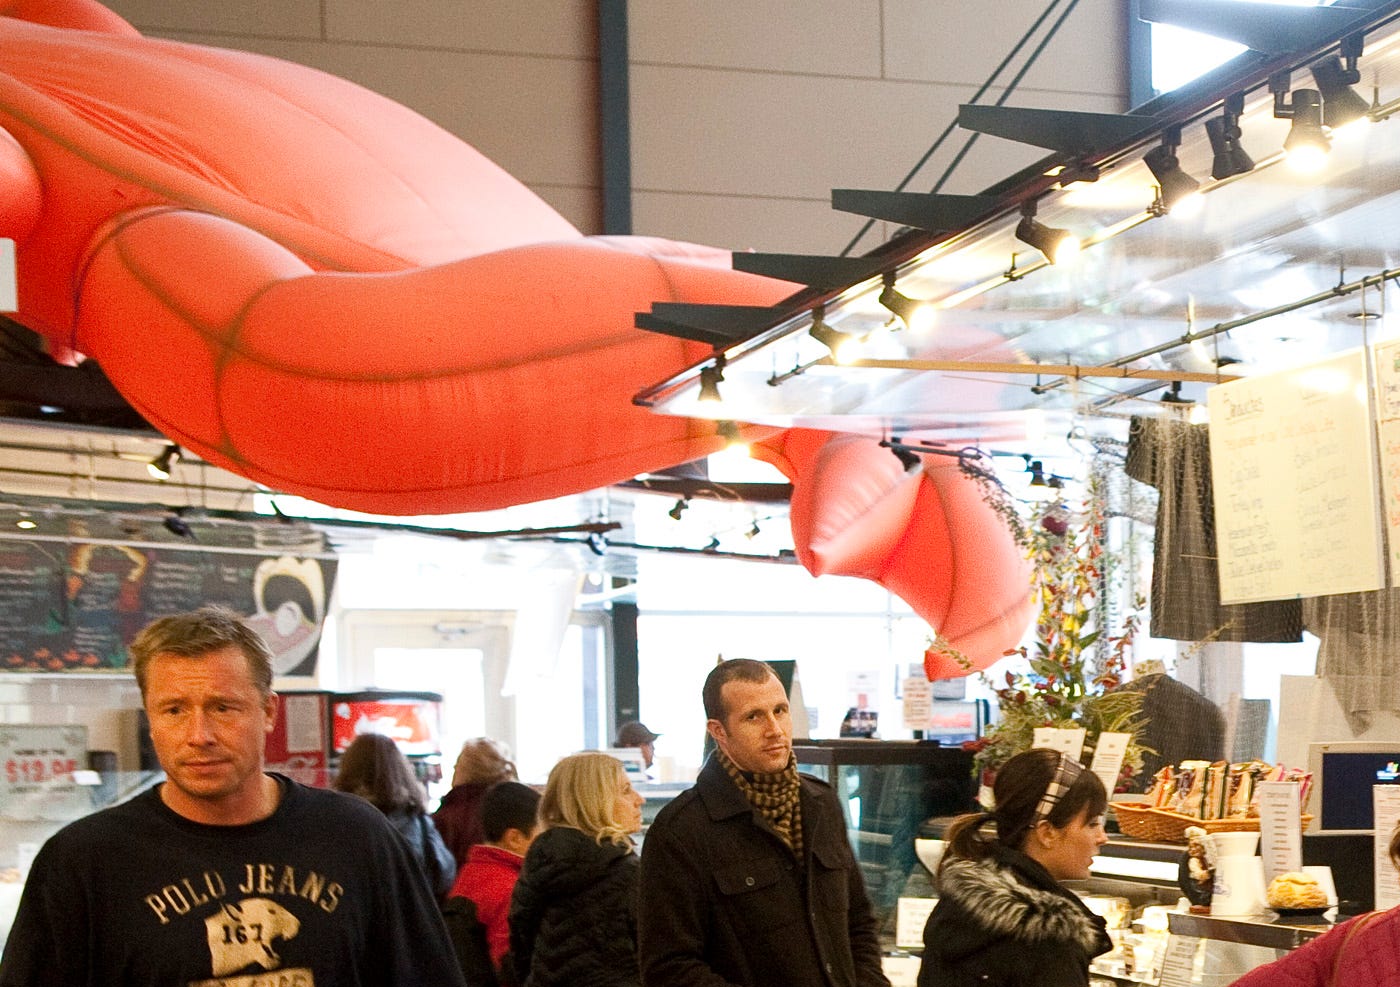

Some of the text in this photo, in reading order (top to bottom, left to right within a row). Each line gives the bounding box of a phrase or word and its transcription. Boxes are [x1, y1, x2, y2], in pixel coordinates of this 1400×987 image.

[145, 863, 344, 925] POLO JEANS
[221, 923, 263, 945] 167
